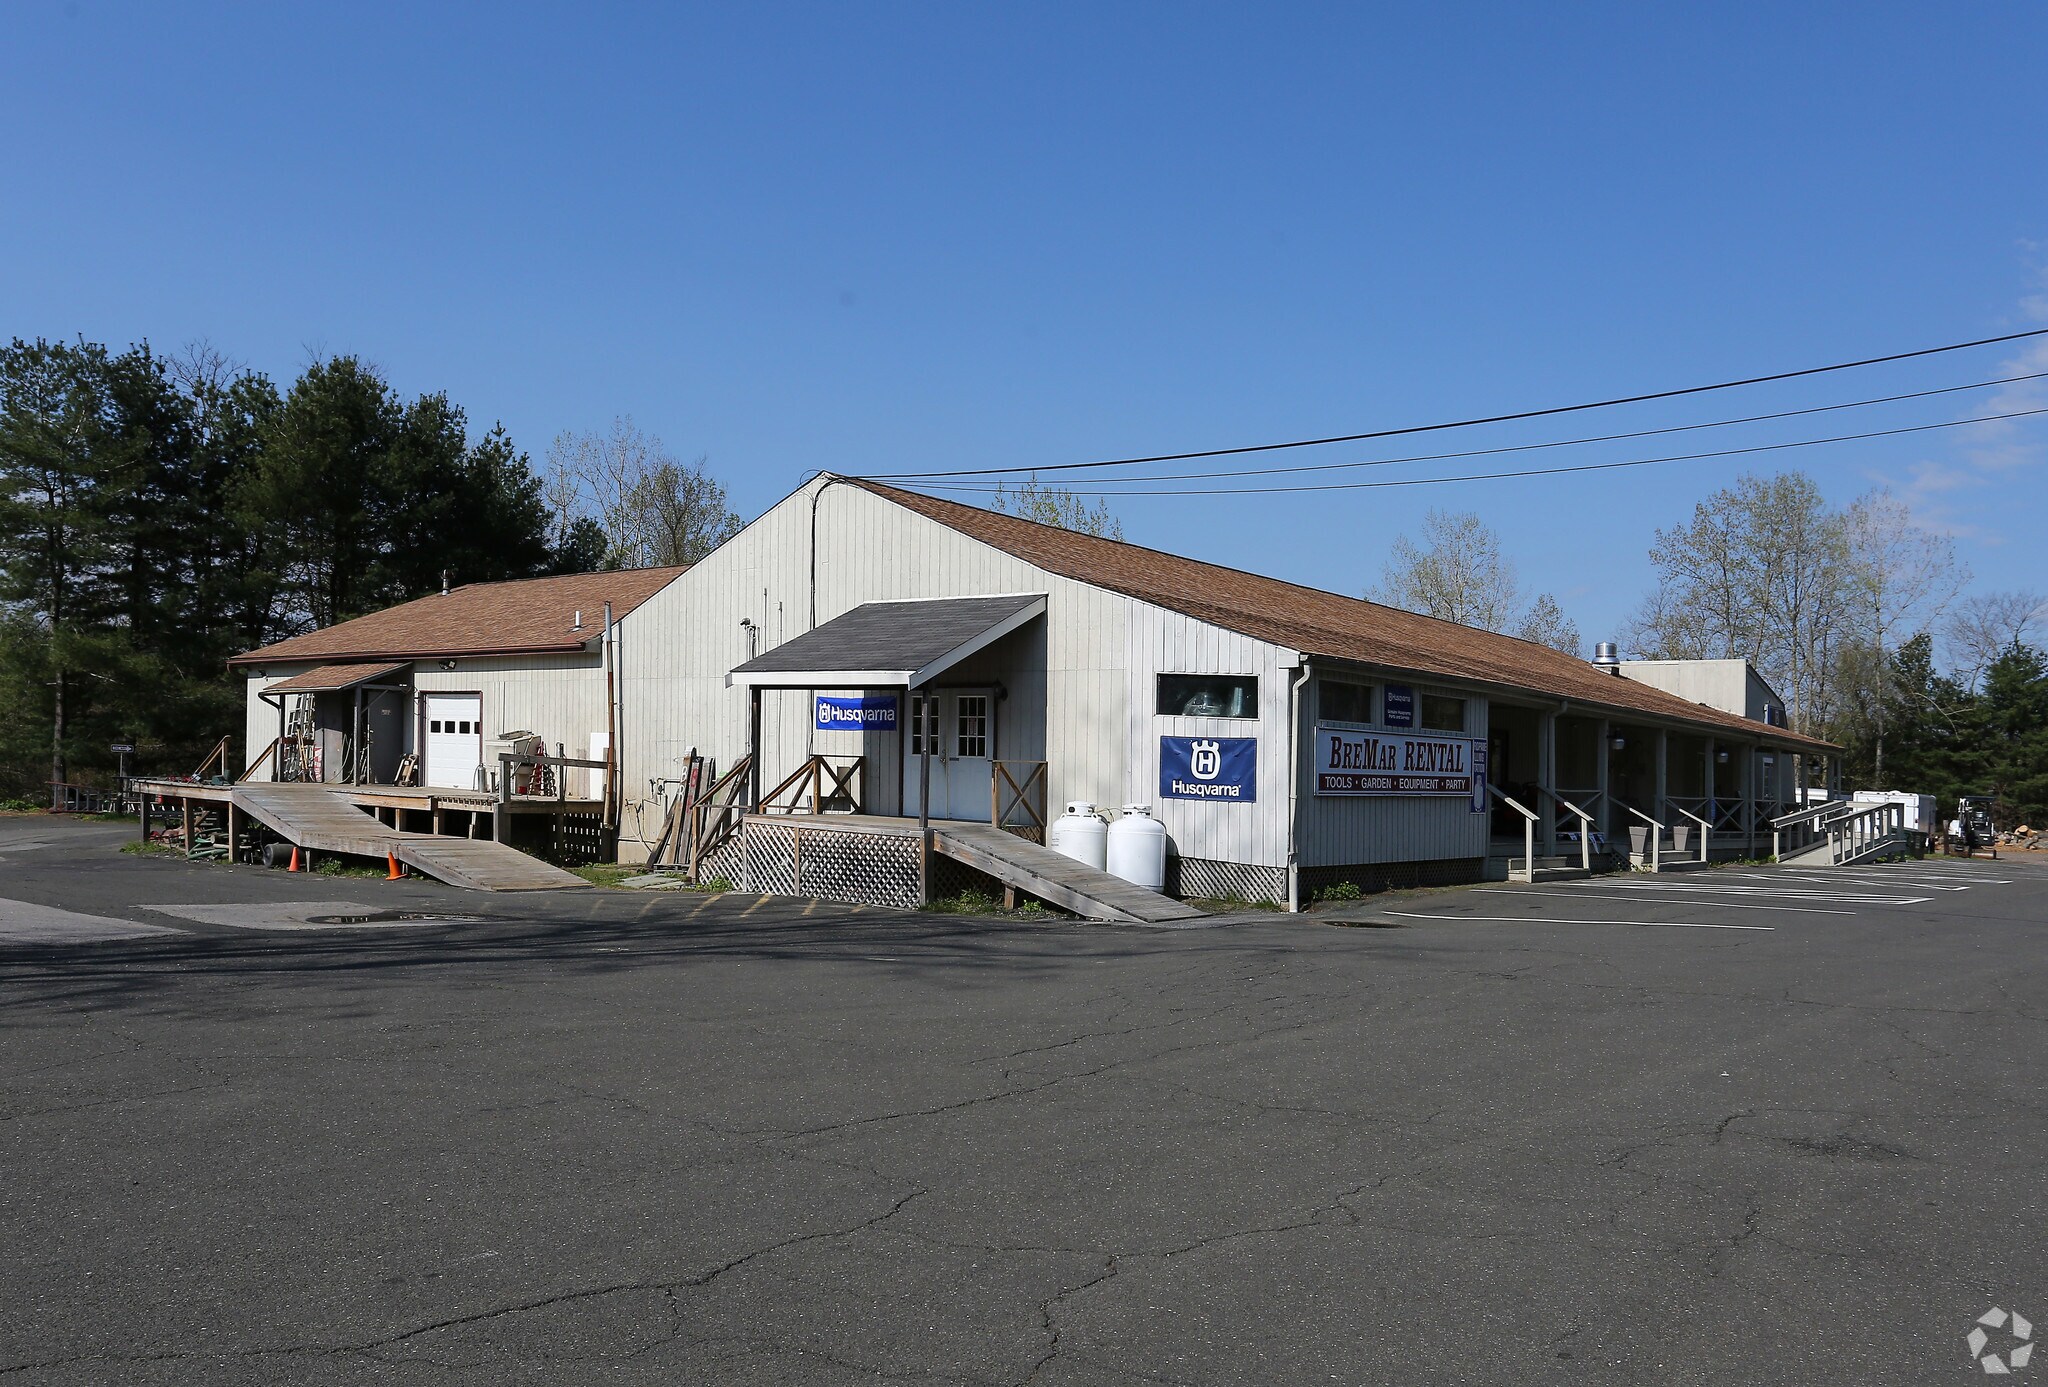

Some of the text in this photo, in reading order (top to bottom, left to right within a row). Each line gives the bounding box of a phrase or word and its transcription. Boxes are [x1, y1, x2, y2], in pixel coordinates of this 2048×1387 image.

[831, 706, 895, 724] Husqvarna
[1403, 741, 1464, 772] RENTAL
[1172, 780, 1239, 797] Husqvarna
[1325, 776, 1466, 790] TOOLS GARDEN EQUIPMENT PARTY
